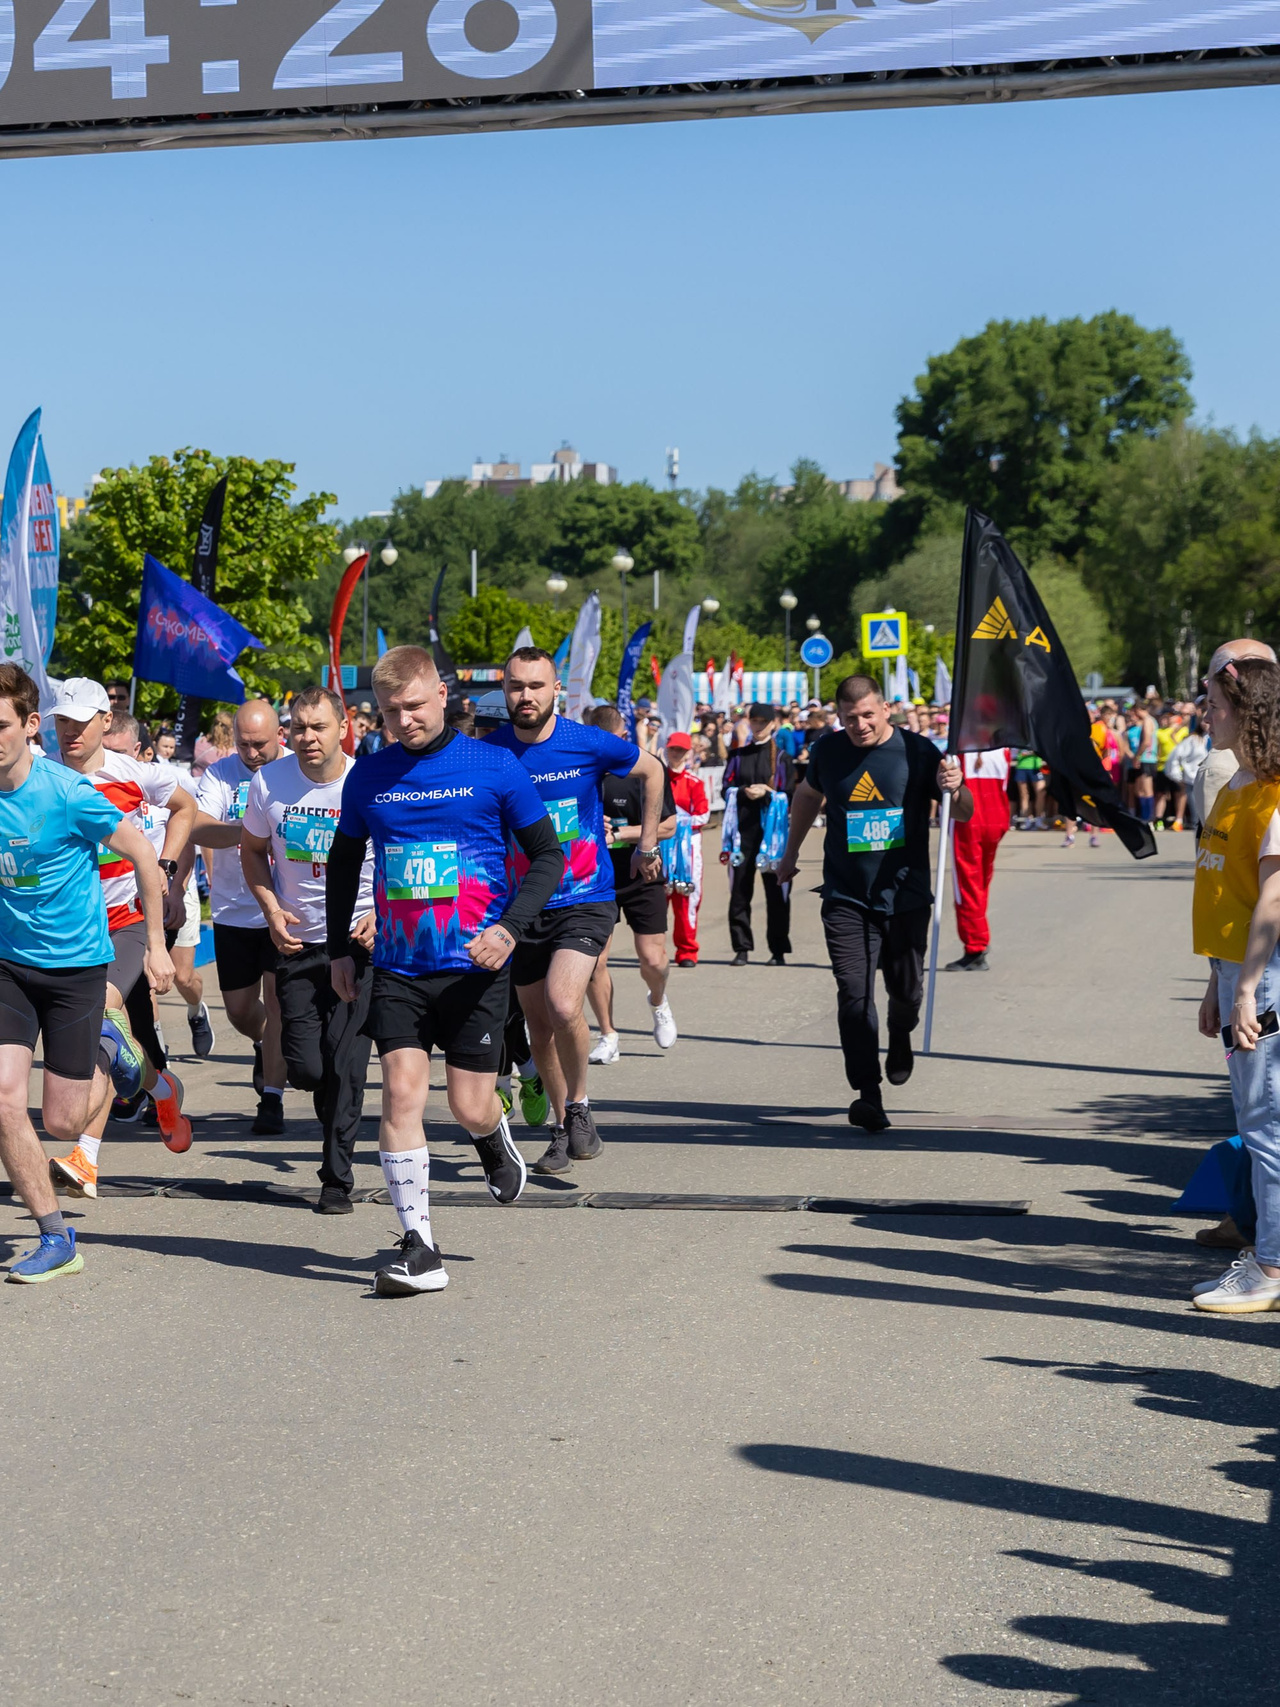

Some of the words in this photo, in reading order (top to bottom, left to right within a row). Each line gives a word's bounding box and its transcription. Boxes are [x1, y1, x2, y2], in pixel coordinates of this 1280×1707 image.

[375, 786, 474, 804] СОВКОМБАНК
[305, 828, 335, 852] 476
[862, 819, 891, 841] 486
[403, 857, 437, 885] 478
[120, 1044, 138, 1068] HOKA
[396, 1205, 415, 1213] FILA
